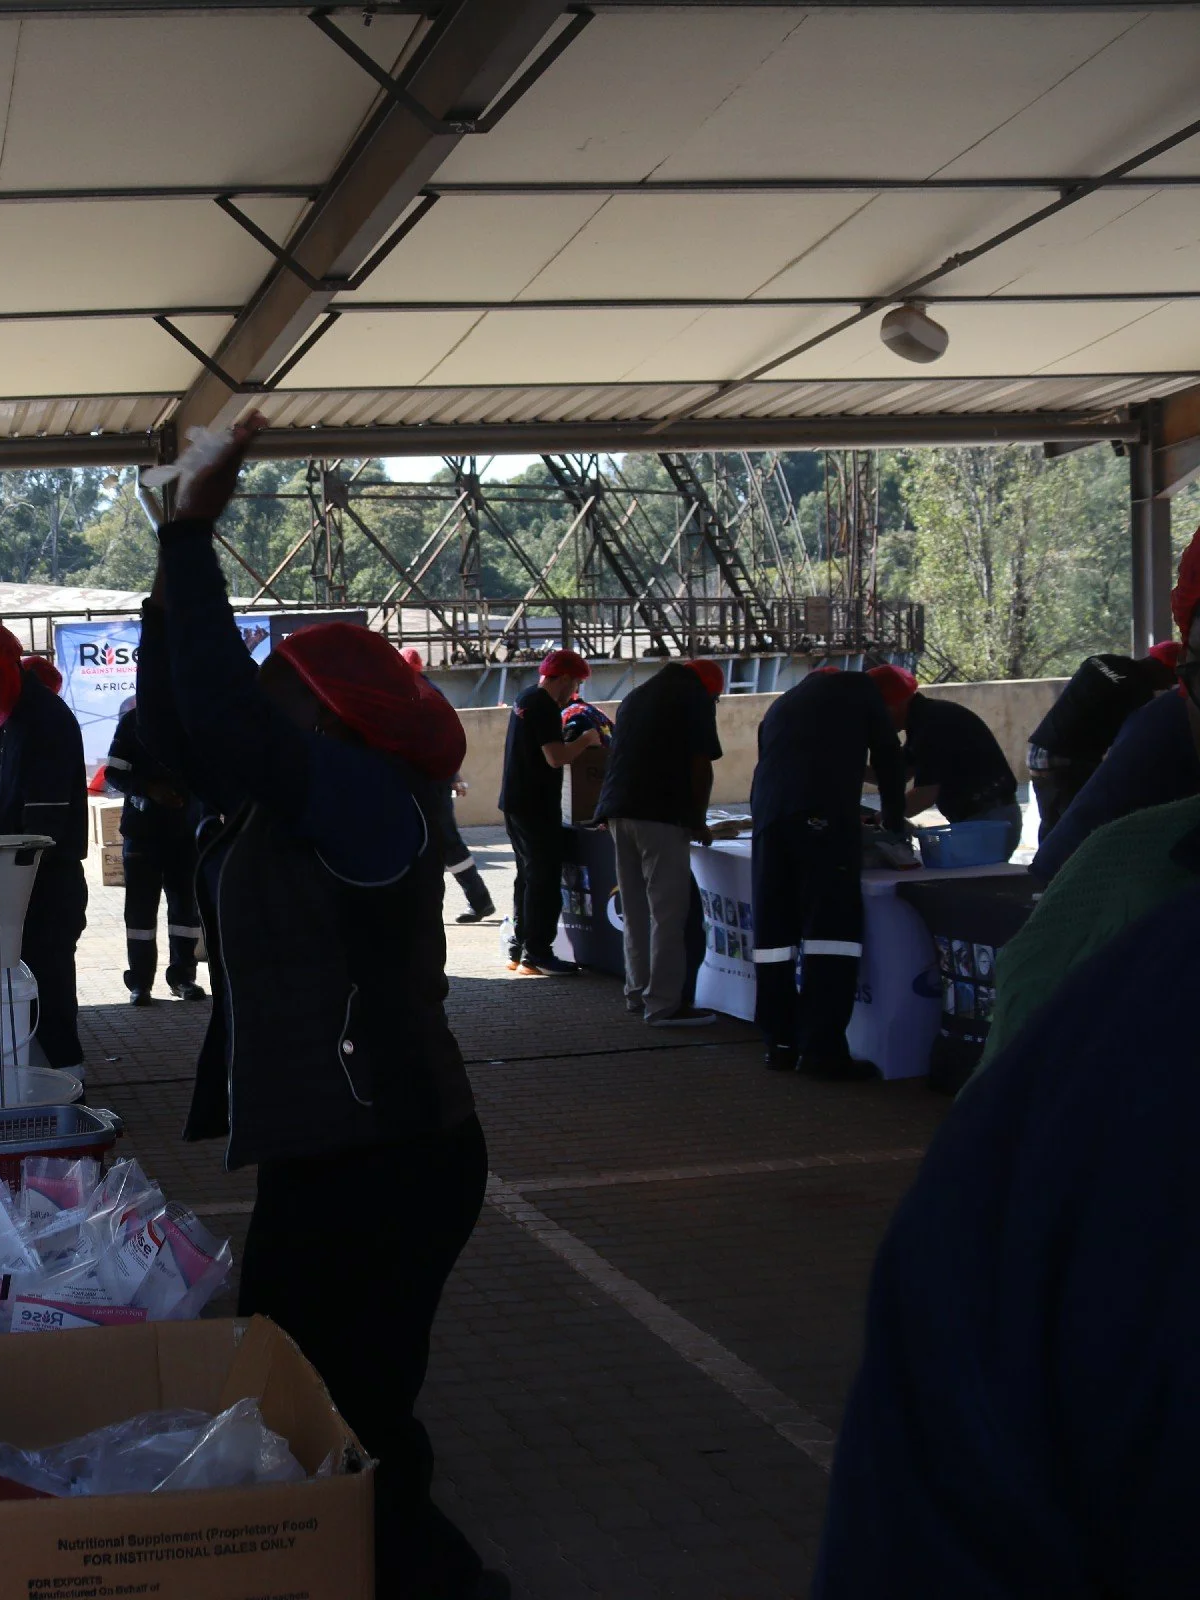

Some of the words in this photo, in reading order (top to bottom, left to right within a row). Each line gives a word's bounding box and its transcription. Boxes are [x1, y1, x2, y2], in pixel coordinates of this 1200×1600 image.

[82, 667, 113, 675] AGAINST
[95, 682, 136, 691] AFRICA
[57, 1534, 125, 1551] Nutritional
[128, 1531, 202, 1549] Supplement
[206, 1523, 279, 1542] (Proprietary
[282, 1517, 319, 1533] Food)
[83, 1554, 112, 1567] FOR
[115, 1547, 210, 1565] INSTITUTIONAL
[214, 1541, 257, 1556] SALES
[260, 1538, 296, 1551] ONLY
[28, 1579, 51, 1589] FOR
[54, 1575, 102, 1587] EXPORTS
[28, 1587, 97, 1600] Manufactured
[99, 1586, 113, 1596] On
[115, 1584, 147, 1595] Behalf
[150, 1583, 160, 1592] of
